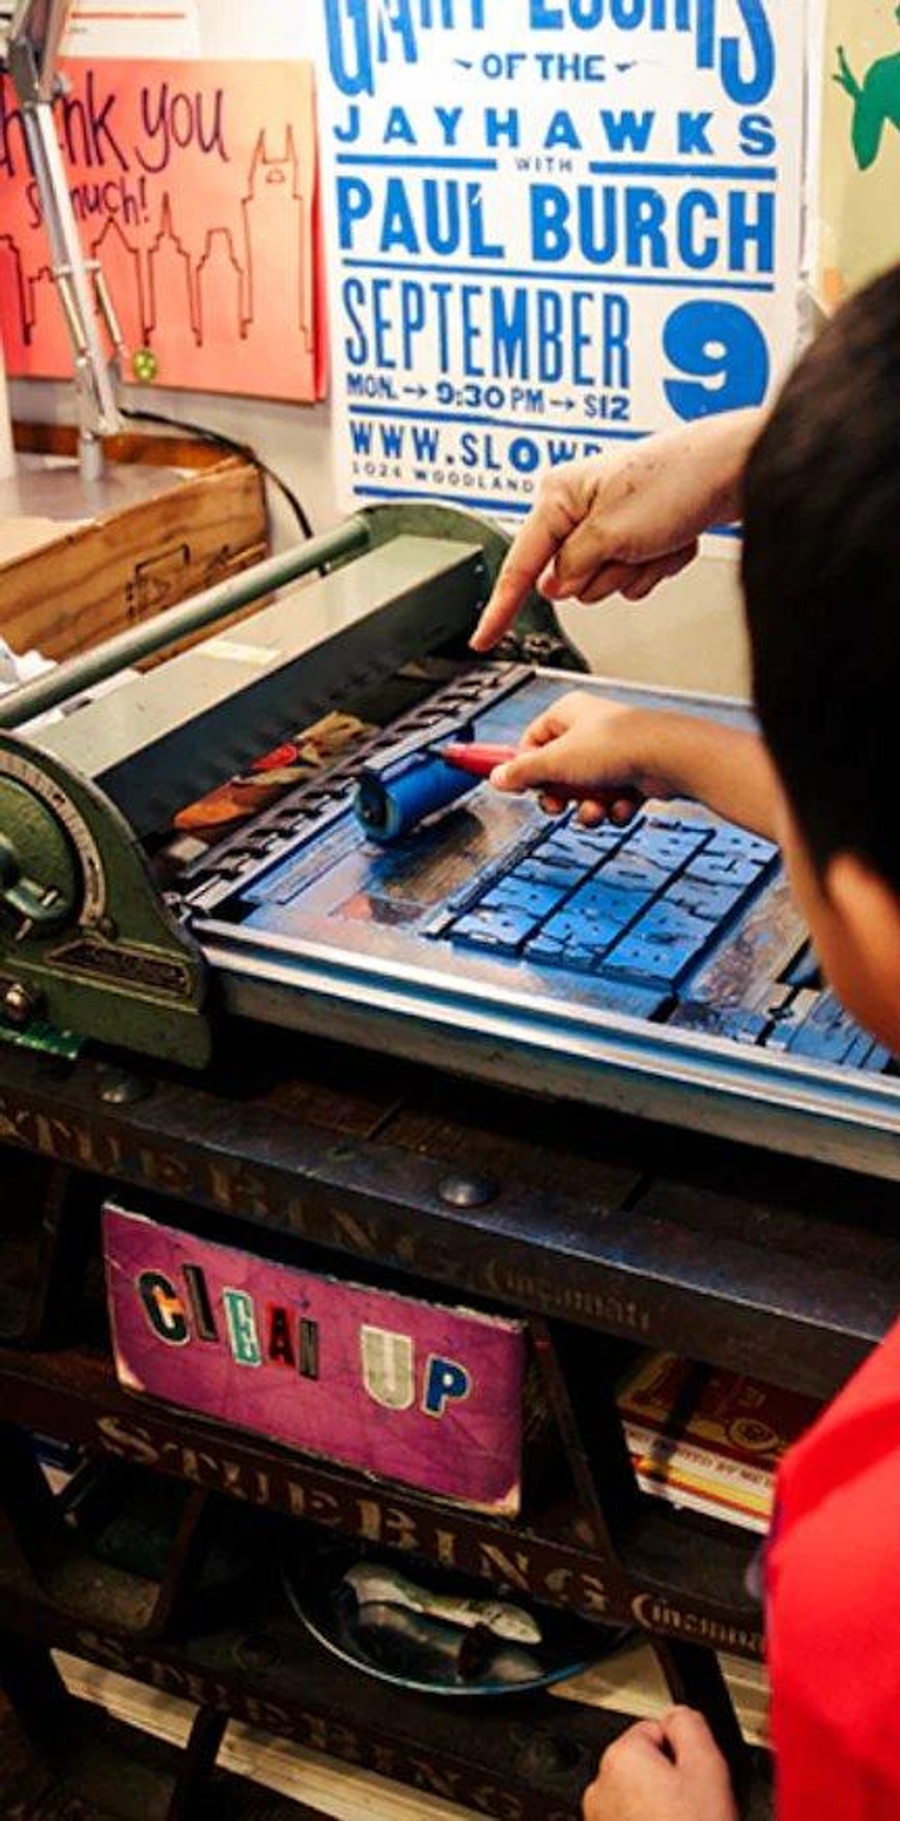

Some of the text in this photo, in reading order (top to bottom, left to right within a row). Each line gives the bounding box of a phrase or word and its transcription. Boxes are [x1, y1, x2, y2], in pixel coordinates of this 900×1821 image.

[481, 53, 605, 81] OF THE
[136, 82, 230, 172] you
[333, 105, 776, 156] JAYHAWKS
[515, 155, 572, 172] WITH
[336, 176, 775, 273] PAUL BURCH
[343, 278, 770, 422] SEPTEMBER 9
[347, 373, 398, 400] MON.
[436, 381, 505, 410] 9:30
[511, 386, 545, 413] PM
[414, 470, 535, 494] WOODLAND
[135, 1264, 474, 1418] CLEAN UP
